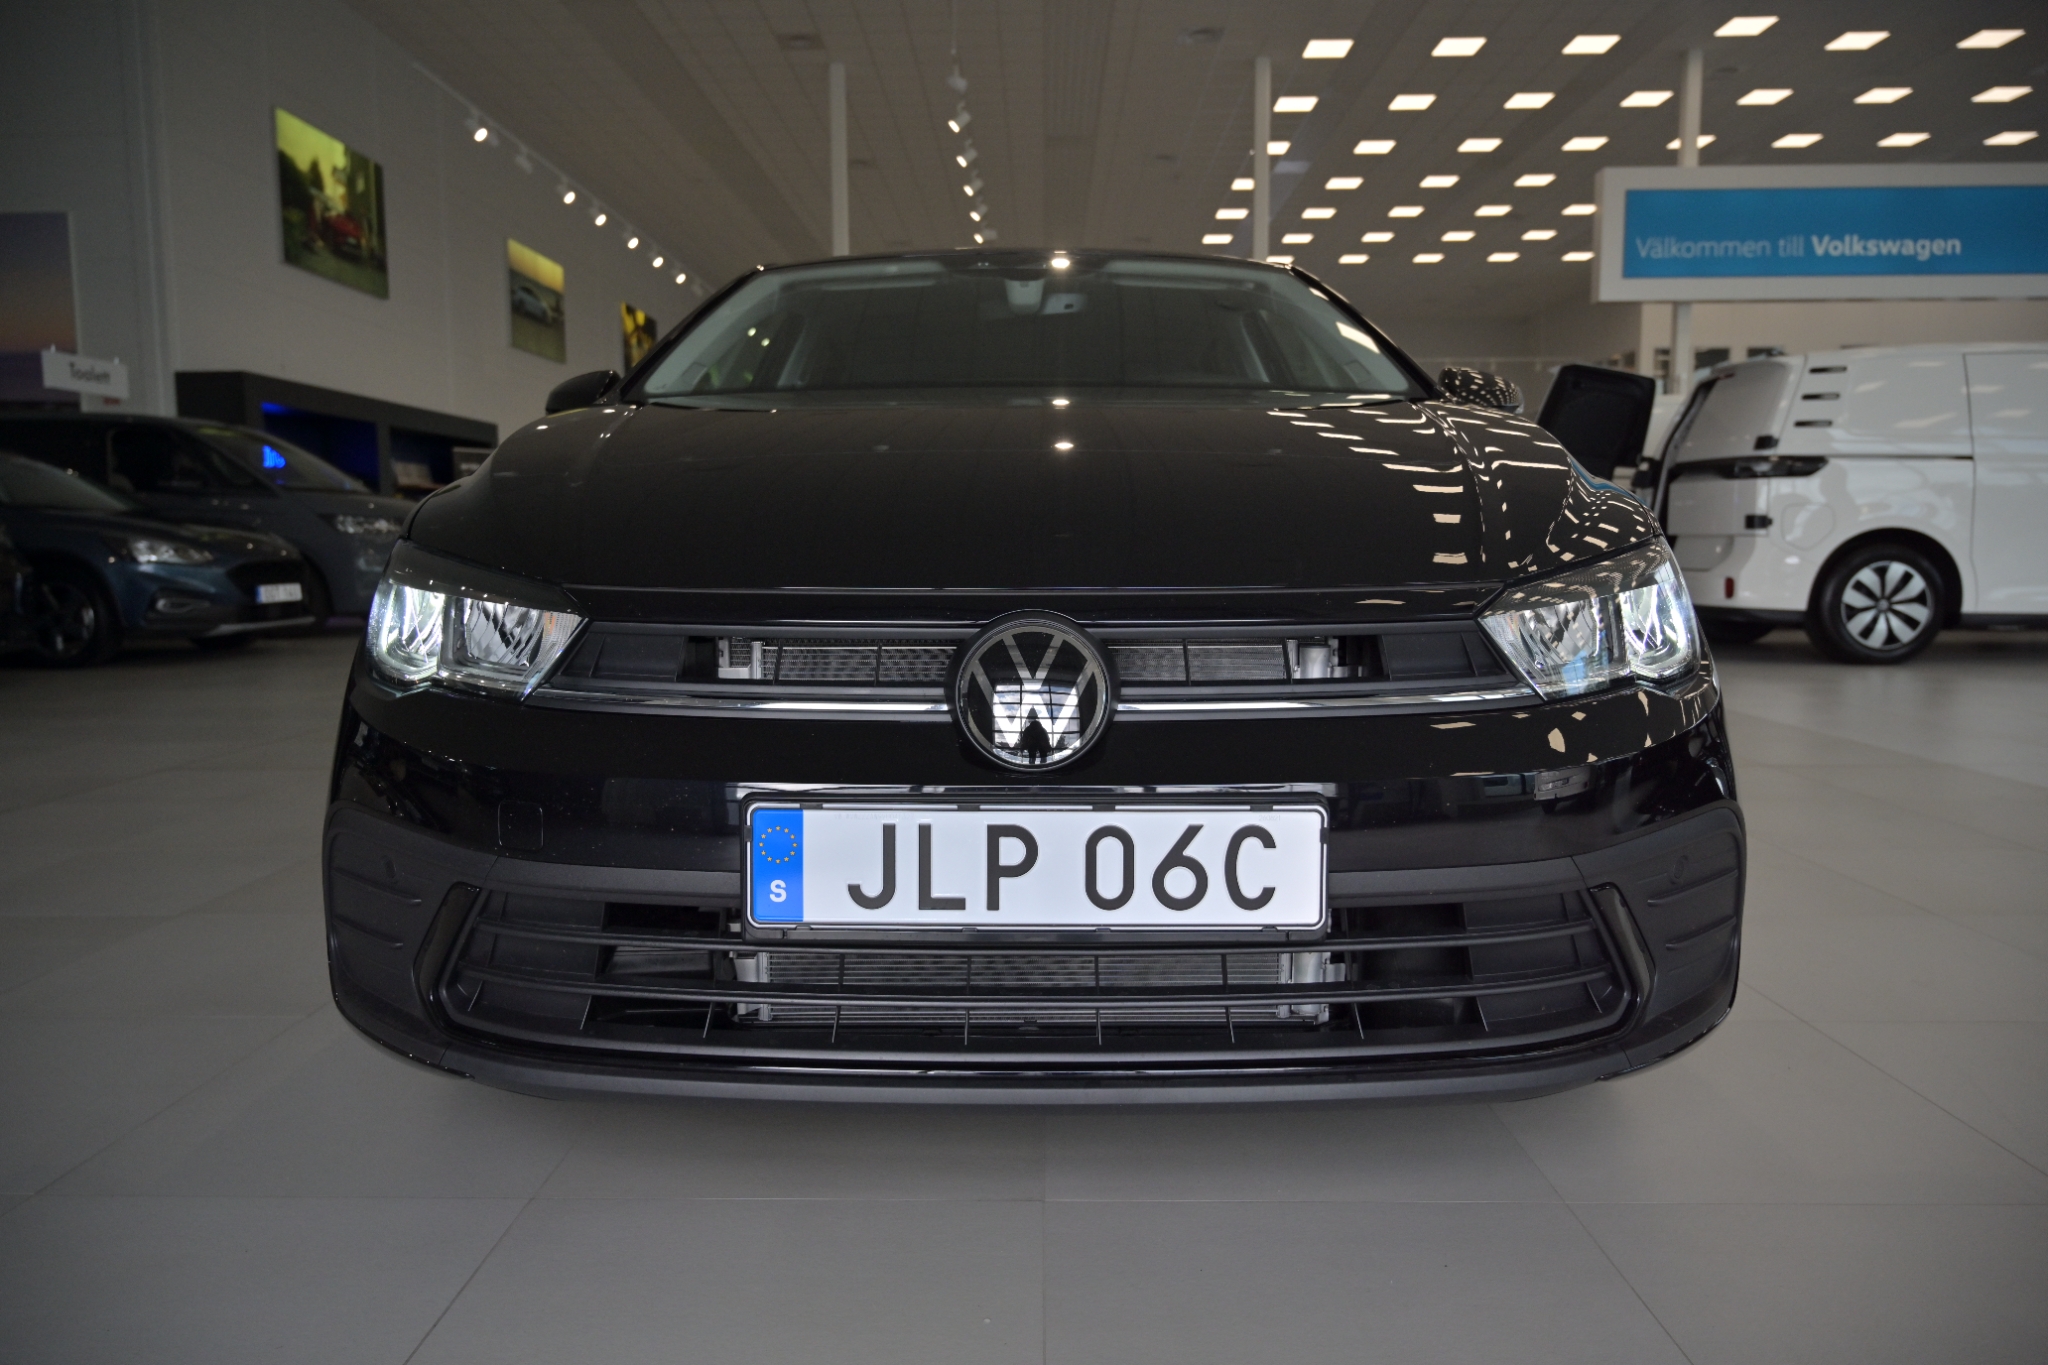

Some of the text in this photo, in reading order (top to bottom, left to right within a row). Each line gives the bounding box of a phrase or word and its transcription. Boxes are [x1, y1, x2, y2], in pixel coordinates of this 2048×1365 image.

[1636, 235, 1962, 261] Välkommen till Volkswagen
[848, 823, 1276, 911] JLP 06C
[769, 879, 787, 903] S
